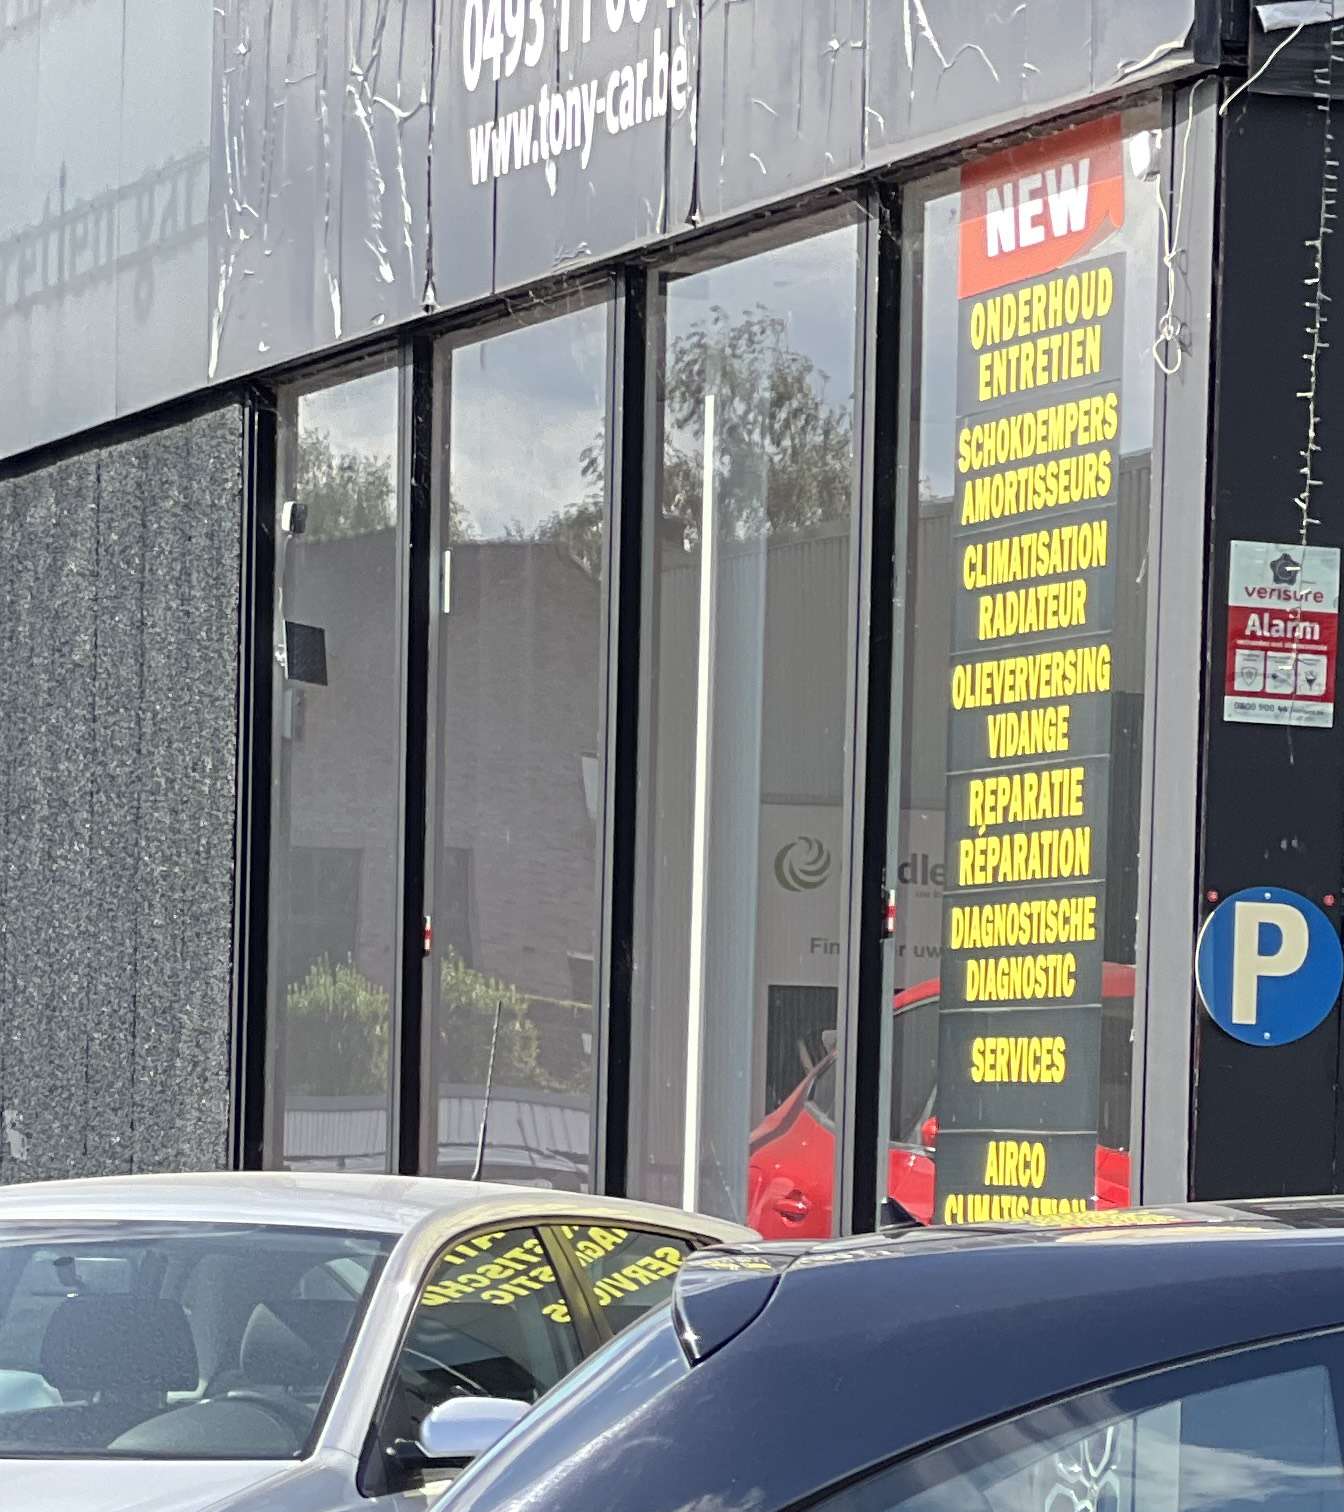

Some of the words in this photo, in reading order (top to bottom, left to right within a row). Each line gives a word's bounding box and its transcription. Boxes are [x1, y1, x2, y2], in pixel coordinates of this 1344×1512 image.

[469, 27, 688, 185] www.tony-car.be
[986, 158, 1090, 257] NEW
[970, 267, 1113, 350] ONDERHOUD
[979, 324, 1101, 401] ENTRETIEN
[958, 392, 1118, 473] SCHOKDEMPERS
[961, 449, 1112, 526] AMORTISSEURS
[963, 520, 1108, 590] CLIMATISATION
[978, 578, 1087, 641] RADIATEUR
[1244, 585, 1324, 604] verisure
[1245, 613, 1320, 641] Alarm
[952, 644, 1111, 710] OLIEVERVERSING
[987, 705, 1070, 759] VIDANGE
[968, 766, 1085, 827] REPARATIE
[959, 825, 1091, 886] RÉPARATION
[950, 896, 1097, 950] DIAGNOSTISCHE
[966, 952, 1077, 1002] DIAGNOSTIC
[1232, 901, 1310, 1025] P
[971, 1036, 1066, 1083] SERVICES
[984, 1140, 1046, 1188] AIRCO
